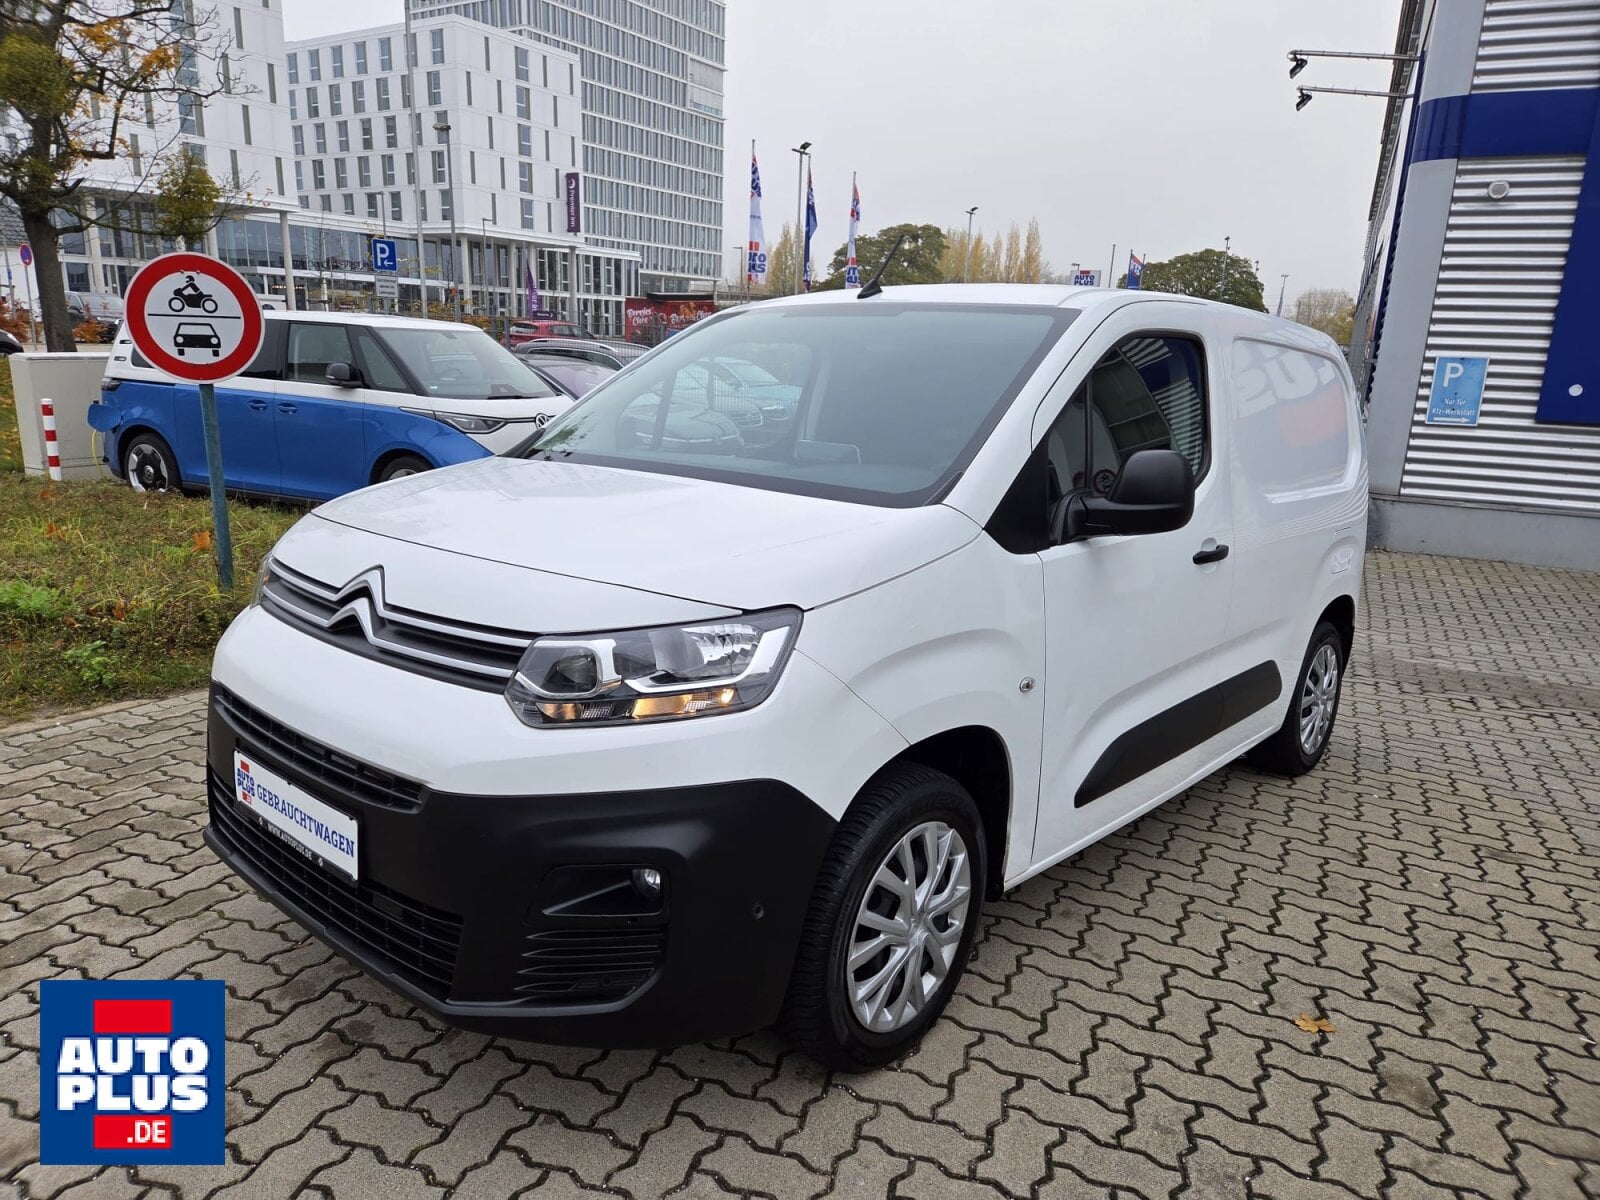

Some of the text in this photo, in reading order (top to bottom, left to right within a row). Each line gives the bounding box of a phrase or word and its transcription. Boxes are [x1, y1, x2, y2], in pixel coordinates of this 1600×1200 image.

[376, 242, 390, 267] P
[1443, 362, 1464, 387] P
[1432, 407, 1475, 416] Kfz-Werkstatt
[237, 767, 255, 787] AUTO
[237, 778, 256, 797] PLUS
[256, 783, 355, 858] GEBRAUCHTWAGEN
